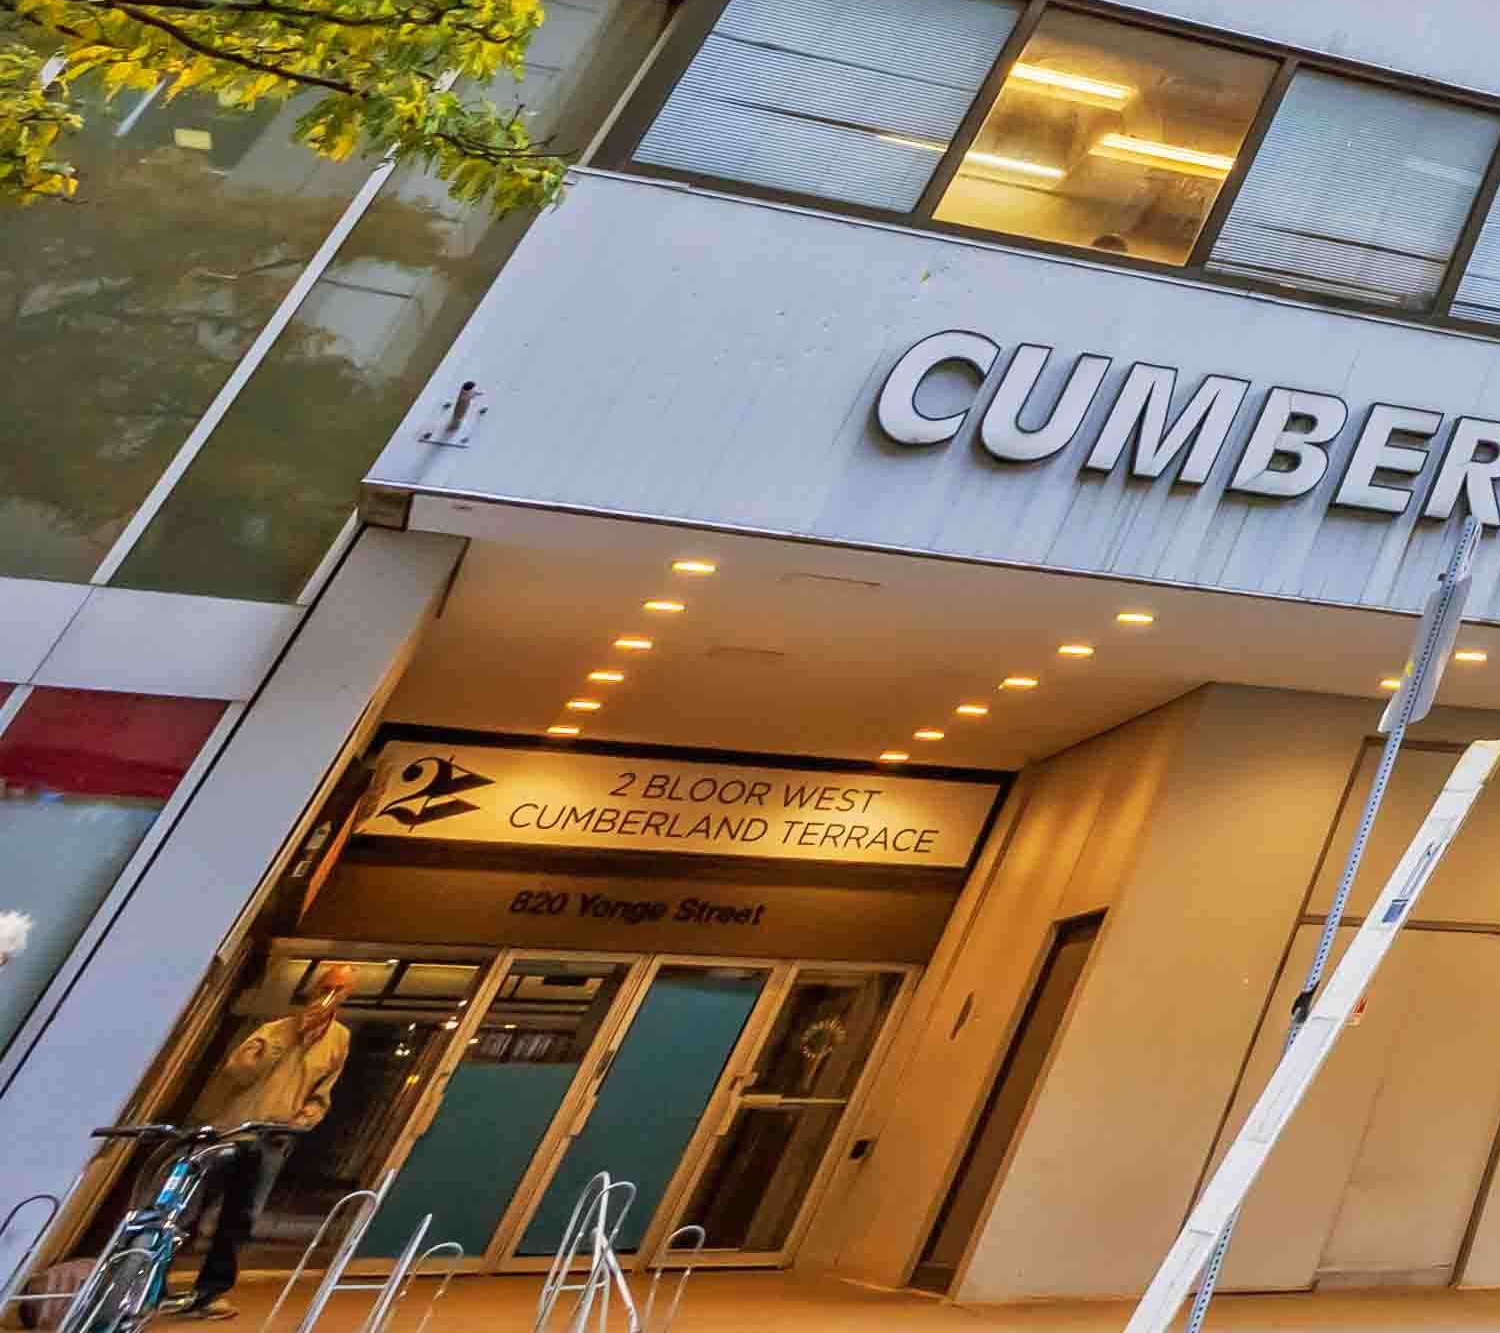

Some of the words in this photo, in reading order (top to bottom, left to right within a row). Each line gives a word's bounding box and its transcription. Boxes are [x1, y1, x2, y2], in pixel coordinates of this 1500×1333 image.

[608, 771, 637, 798] 2
[641, 774, 772, 806] BLOOR
[782, 784, 884, 814] WEST
[508, 802, 769, 844] CUMBERLAND
[780, 820, 940, 854] TERRACE
[508, 889, 569, 916] 820
[575, 893, 668, 925] Yonge
[673, 897, 768, 927] Street
